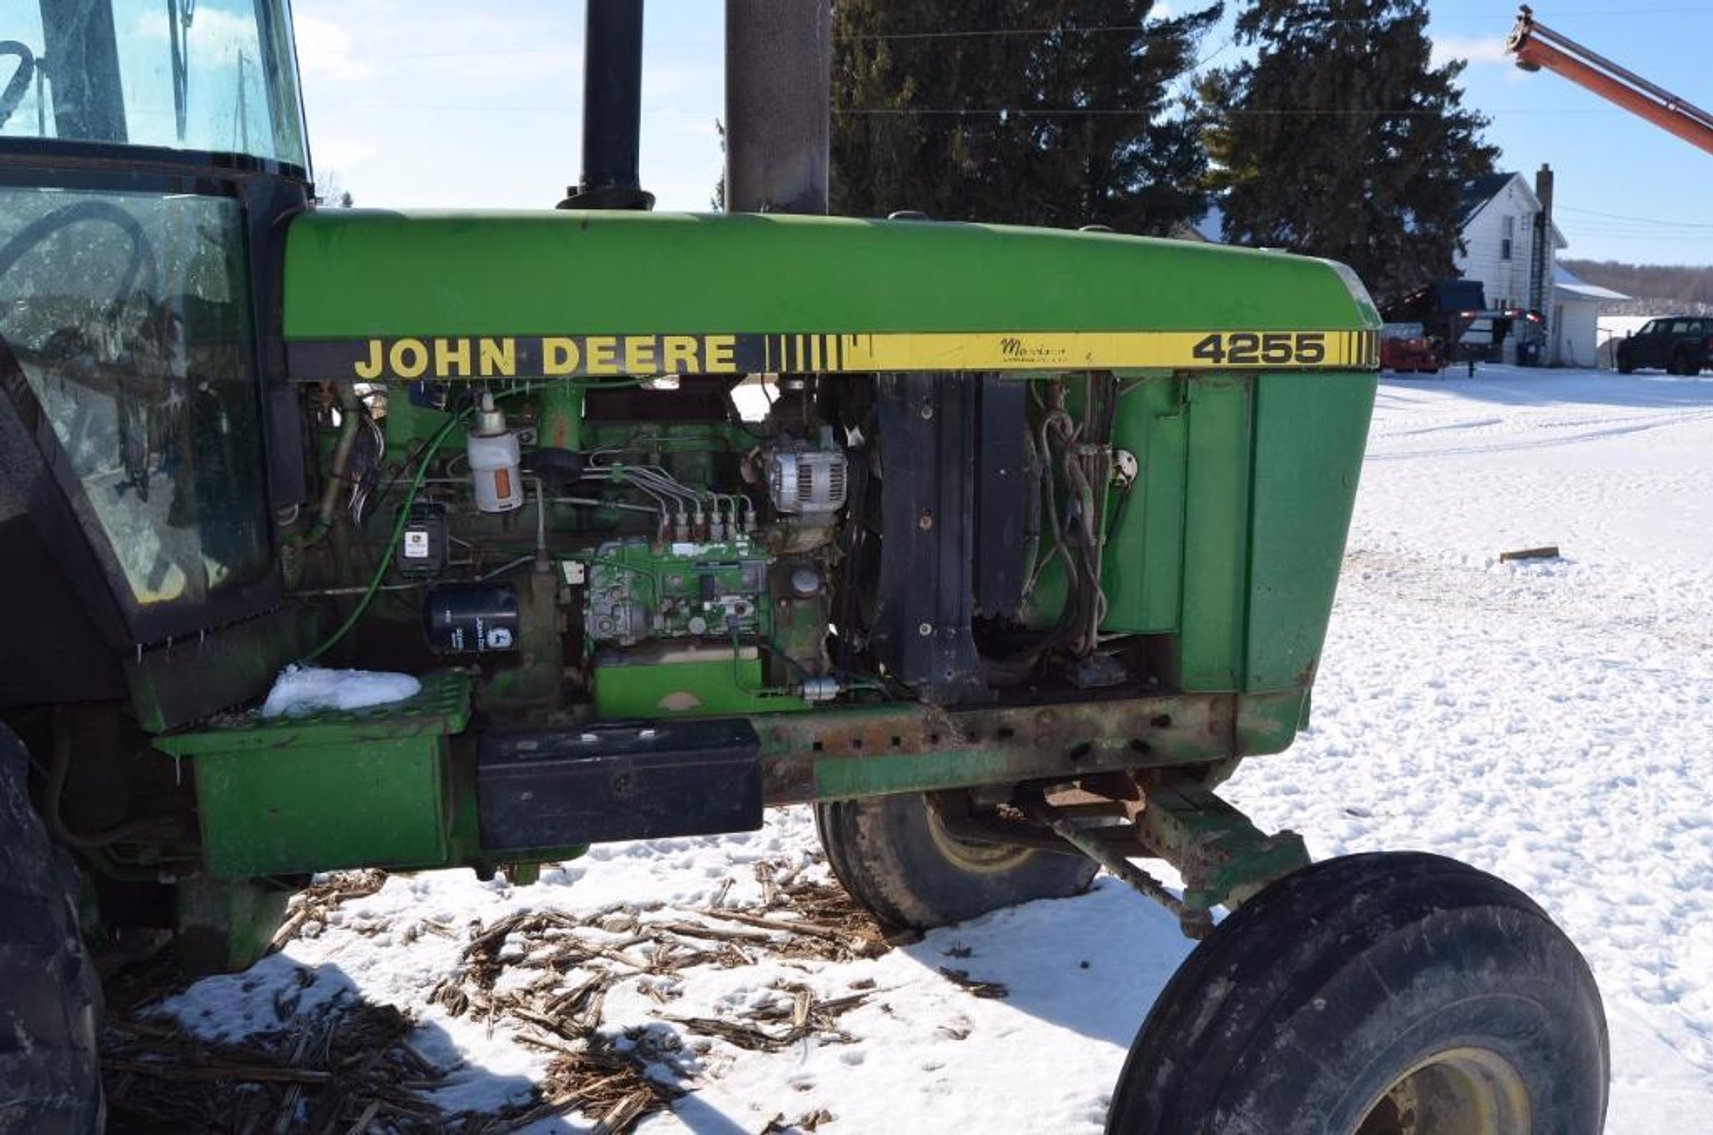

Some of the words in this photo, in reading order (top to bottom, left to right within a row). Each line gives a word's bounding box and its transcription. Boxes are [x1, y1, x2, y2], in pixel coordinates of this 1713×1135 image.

[354, 338, 517, 379] JOHN
[542, 335, 737, 374] DEERE
[1192, 333, 1326, 364] 4255
